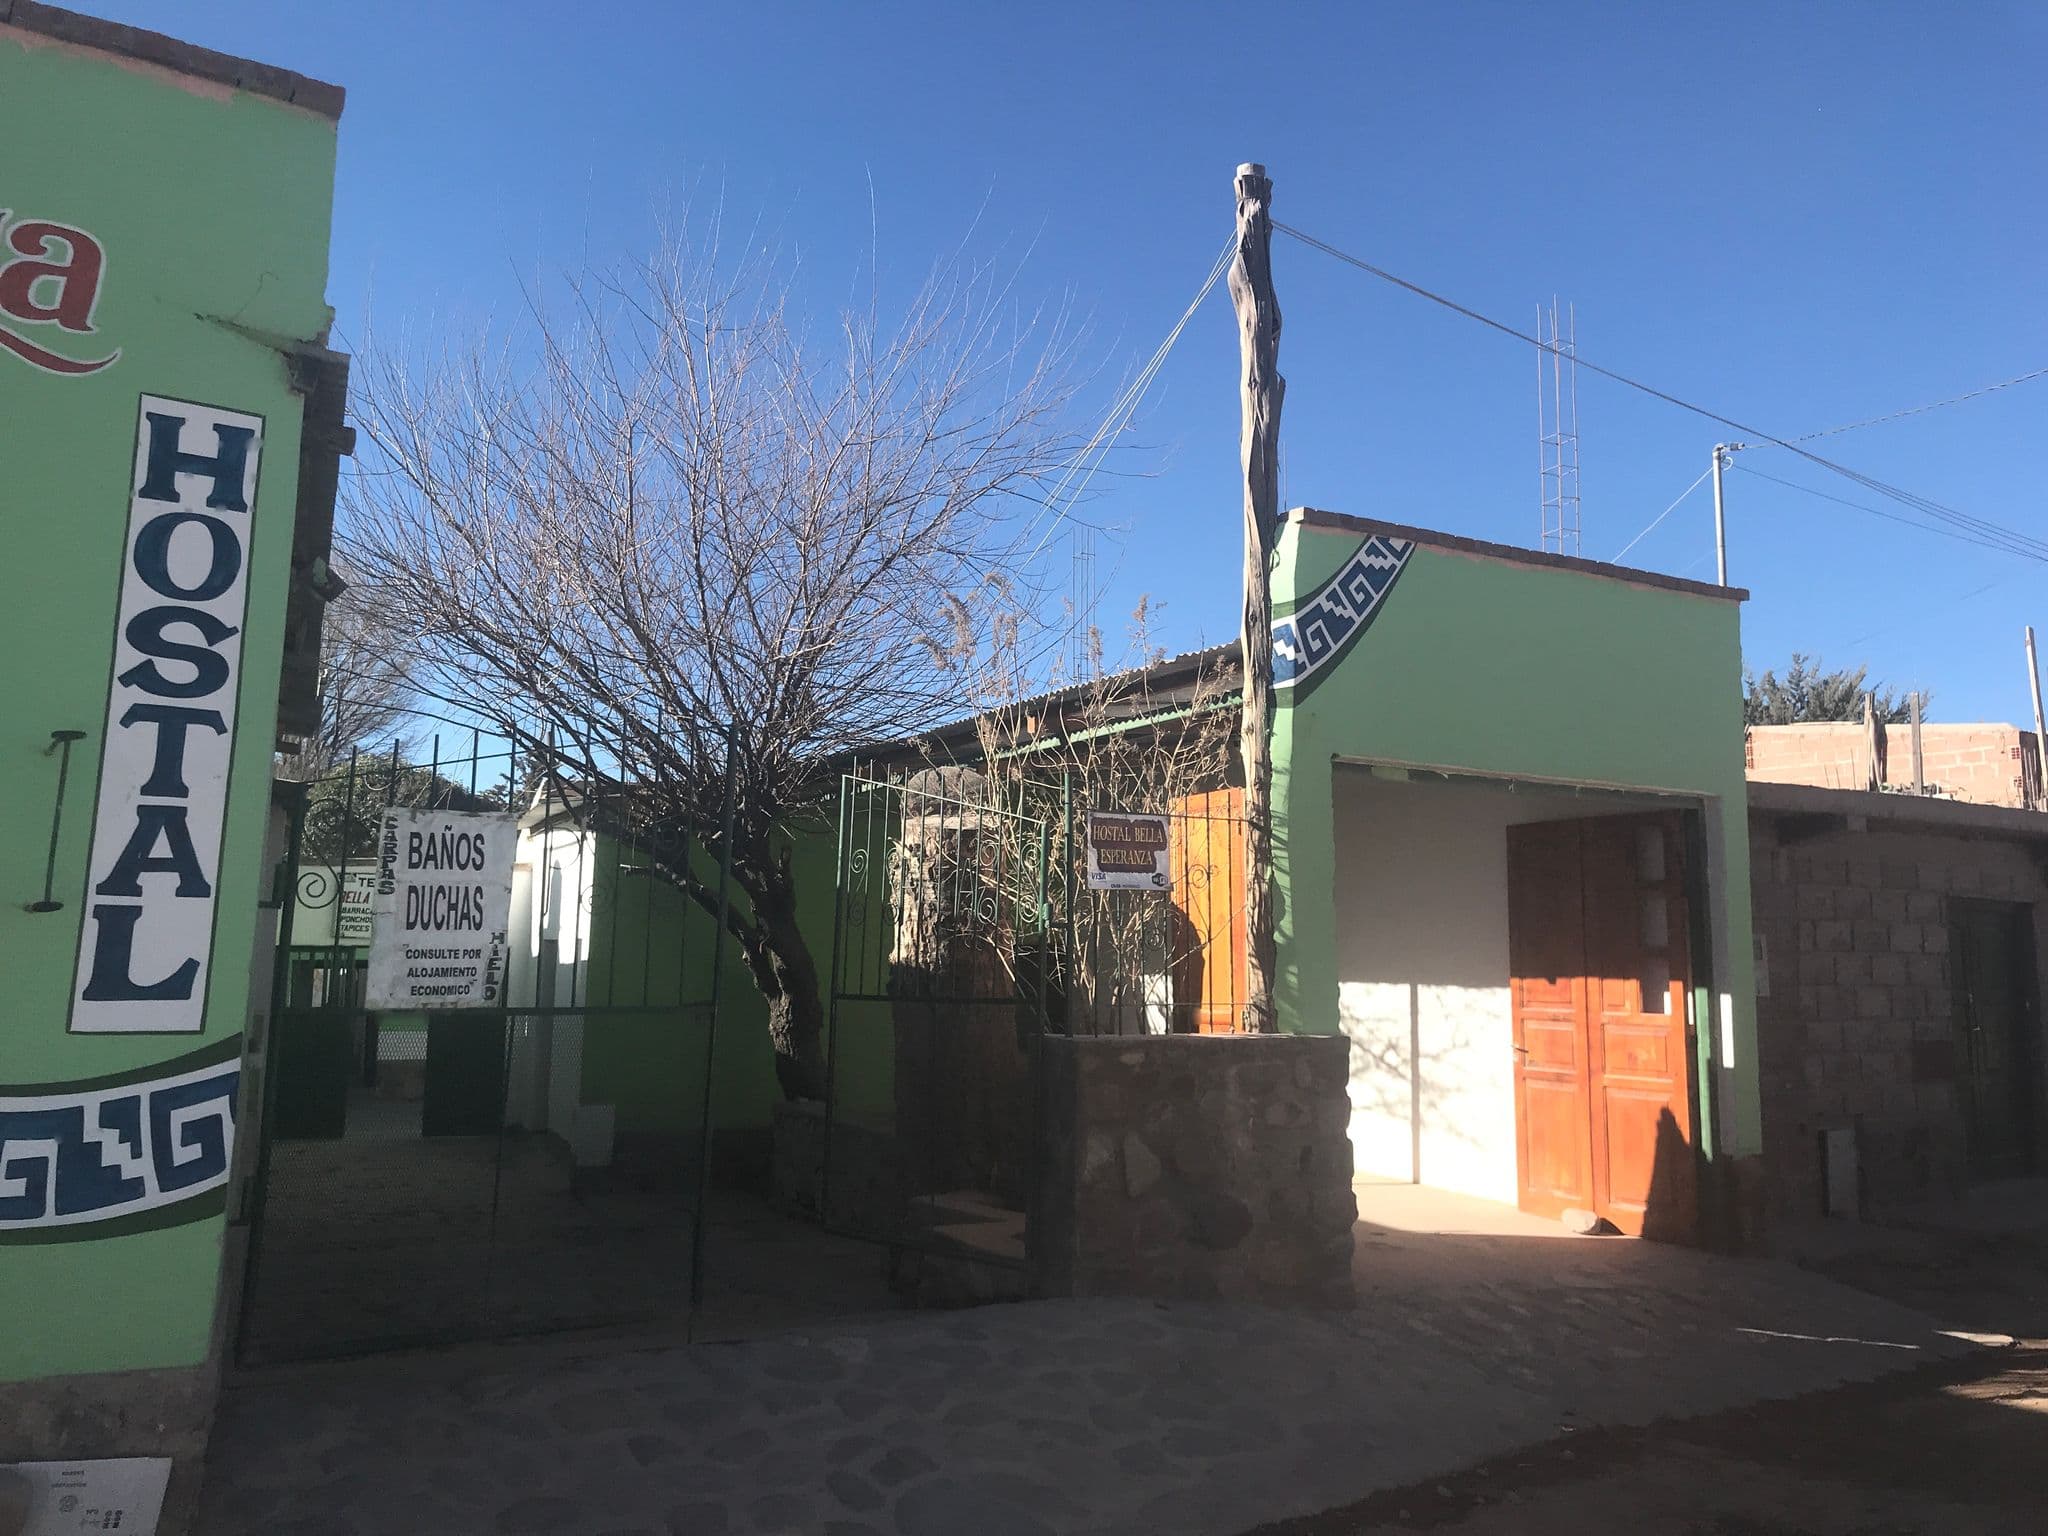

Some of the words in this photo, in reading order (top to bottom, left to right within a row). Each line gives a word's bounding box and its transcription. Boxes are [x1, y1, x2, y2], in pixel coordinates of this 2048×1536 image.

[82, 411, 256, 1001] HOSTAL
[1093, 825, 1131, 841] HOSTAL
[1134, 827, 1163, 842] BELLA
[377, 816, 399, 895] CARPAS
[407, 825, 485, 871] BAÑOS
[1100, 849, 1153, 865] ESPERANZA
[406, 885, 484, 931] DUCHAS
[340, 924, 370, 932] TAPICES
[462, 949, 481, 959] POR
[407, 967, 477, 978] ALOJAMIENTO
